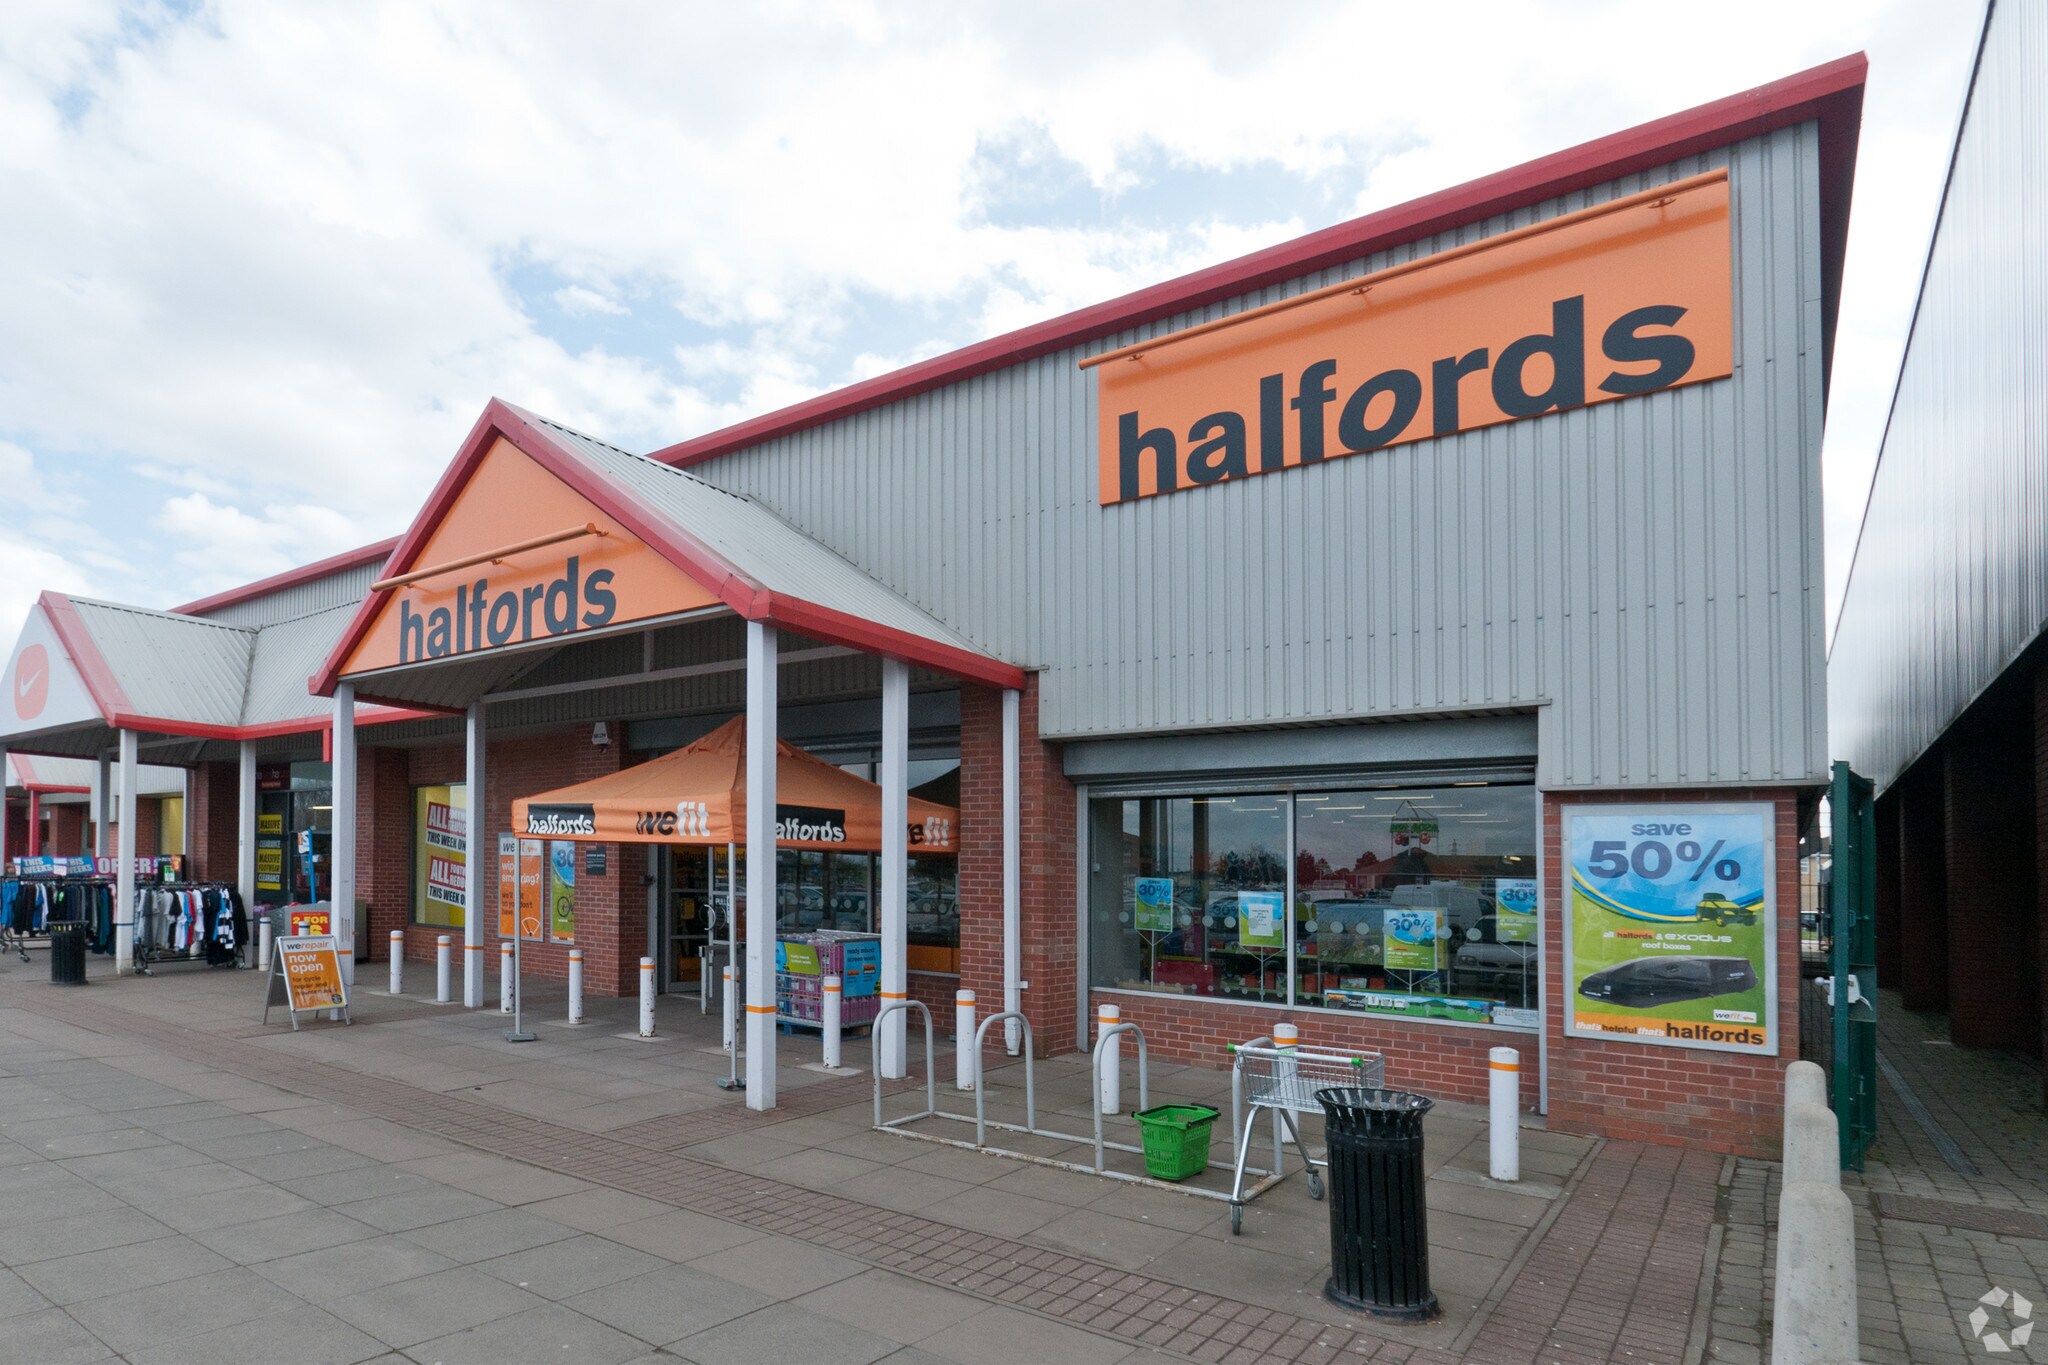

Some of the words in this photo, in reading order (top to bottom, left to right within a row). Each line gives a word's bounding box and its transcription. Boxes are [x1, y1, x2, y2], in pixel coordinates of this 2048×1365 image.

[1118, 294, 1696, 501] halfords
[400, 555, 617, 664] halfords
[428, 804, 447, 829] ALL
[636, 801, 710, 837] wefit
[527, 814, 595, 835] halfords
[776, 817, 845, 842] alfords
[907, 816, 949, 847] efit
[1632, 823, 1692, 836] save
[427, 831, 440, 844] THIS
[440, 834, 457, 849] WEEK
[458, 838, 466, 851] ON
[24, 857, 44, 866] THIS
[259, 853, 280, 863] MASSIVE
[1588, 840, 1741, 882] 50%
[23, 864, 53, 875] WEEKS
[430, 859, 449, 884] ALL
[258, 874, 280, 882] CLEARANCE
[429, 885, 442, 899] THIS
[443, 889, 462, 904] WEEK
[1138, 884, 1169, 898] 30%
[293, 916, 300, 924] 2
[304, 916, 328, 924] FOR
[1388, 918, 1431, 933] 30%
[1603, 930, 1614, 939] all
[1617, 931, 1653, 940] halfords
[1656, 933, 1662, 941] &
[1664, 933, 1732, 943] exodus
[287, 941, 329, 950] werepair
[1641, 941, 1661, 949] roof
[1662, 942, 1692, 951] boxes
[289, 954, 317, 963] now
[290, 963, 324, 974] open
[1715, 1011, 1741, 1021] wefit
[1602, 1024, 1637, 1035] helpful
[1666, 1023, 1764, 1045] halfords
